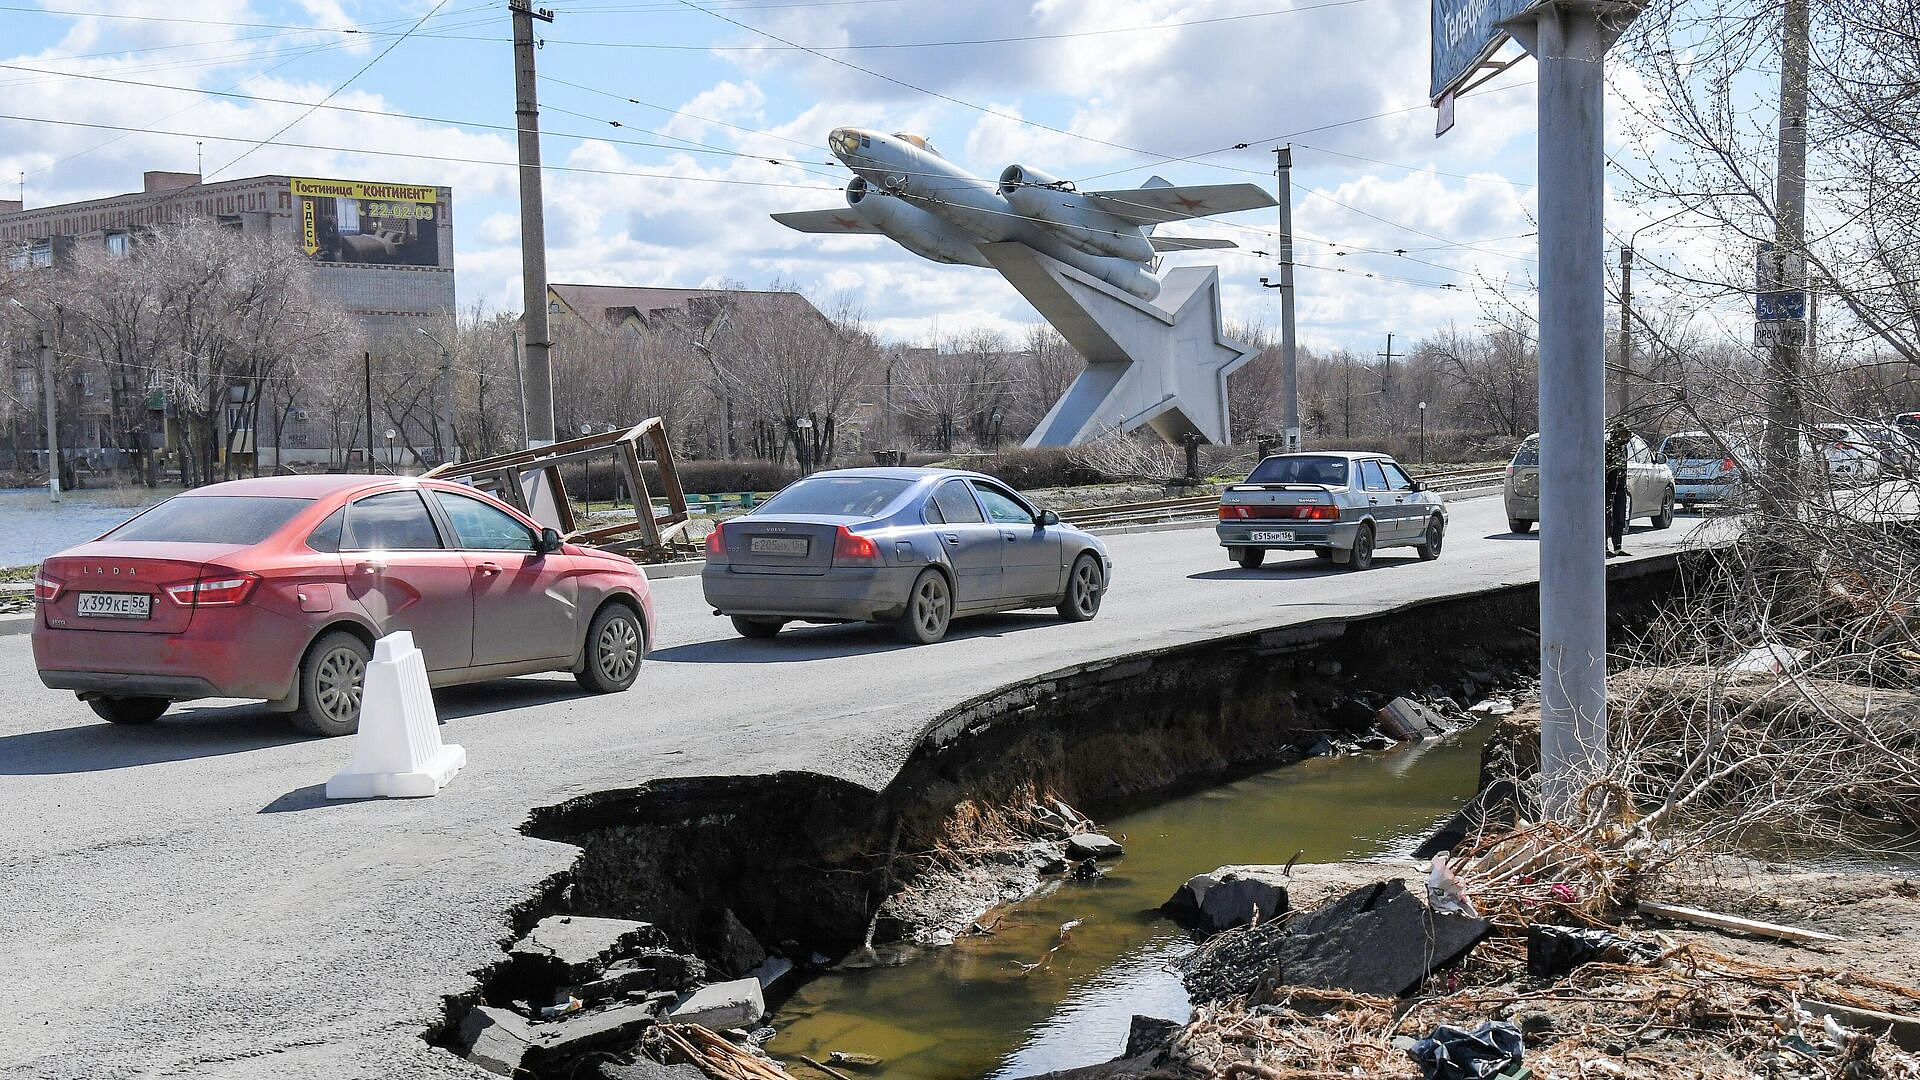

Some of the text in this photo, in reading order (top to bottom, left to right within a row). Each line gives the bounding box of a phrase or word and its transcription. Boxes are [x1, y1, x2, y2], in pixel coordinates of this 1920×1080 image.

[295, 181, 353, 197] Гостиница
[371, 202, 433, 220] 22-02-03
[305, 202, 313, 247] ЗДЕСЬ
[84, 566, 136, 576] LADA
[132, 597, 146, 608] 56
